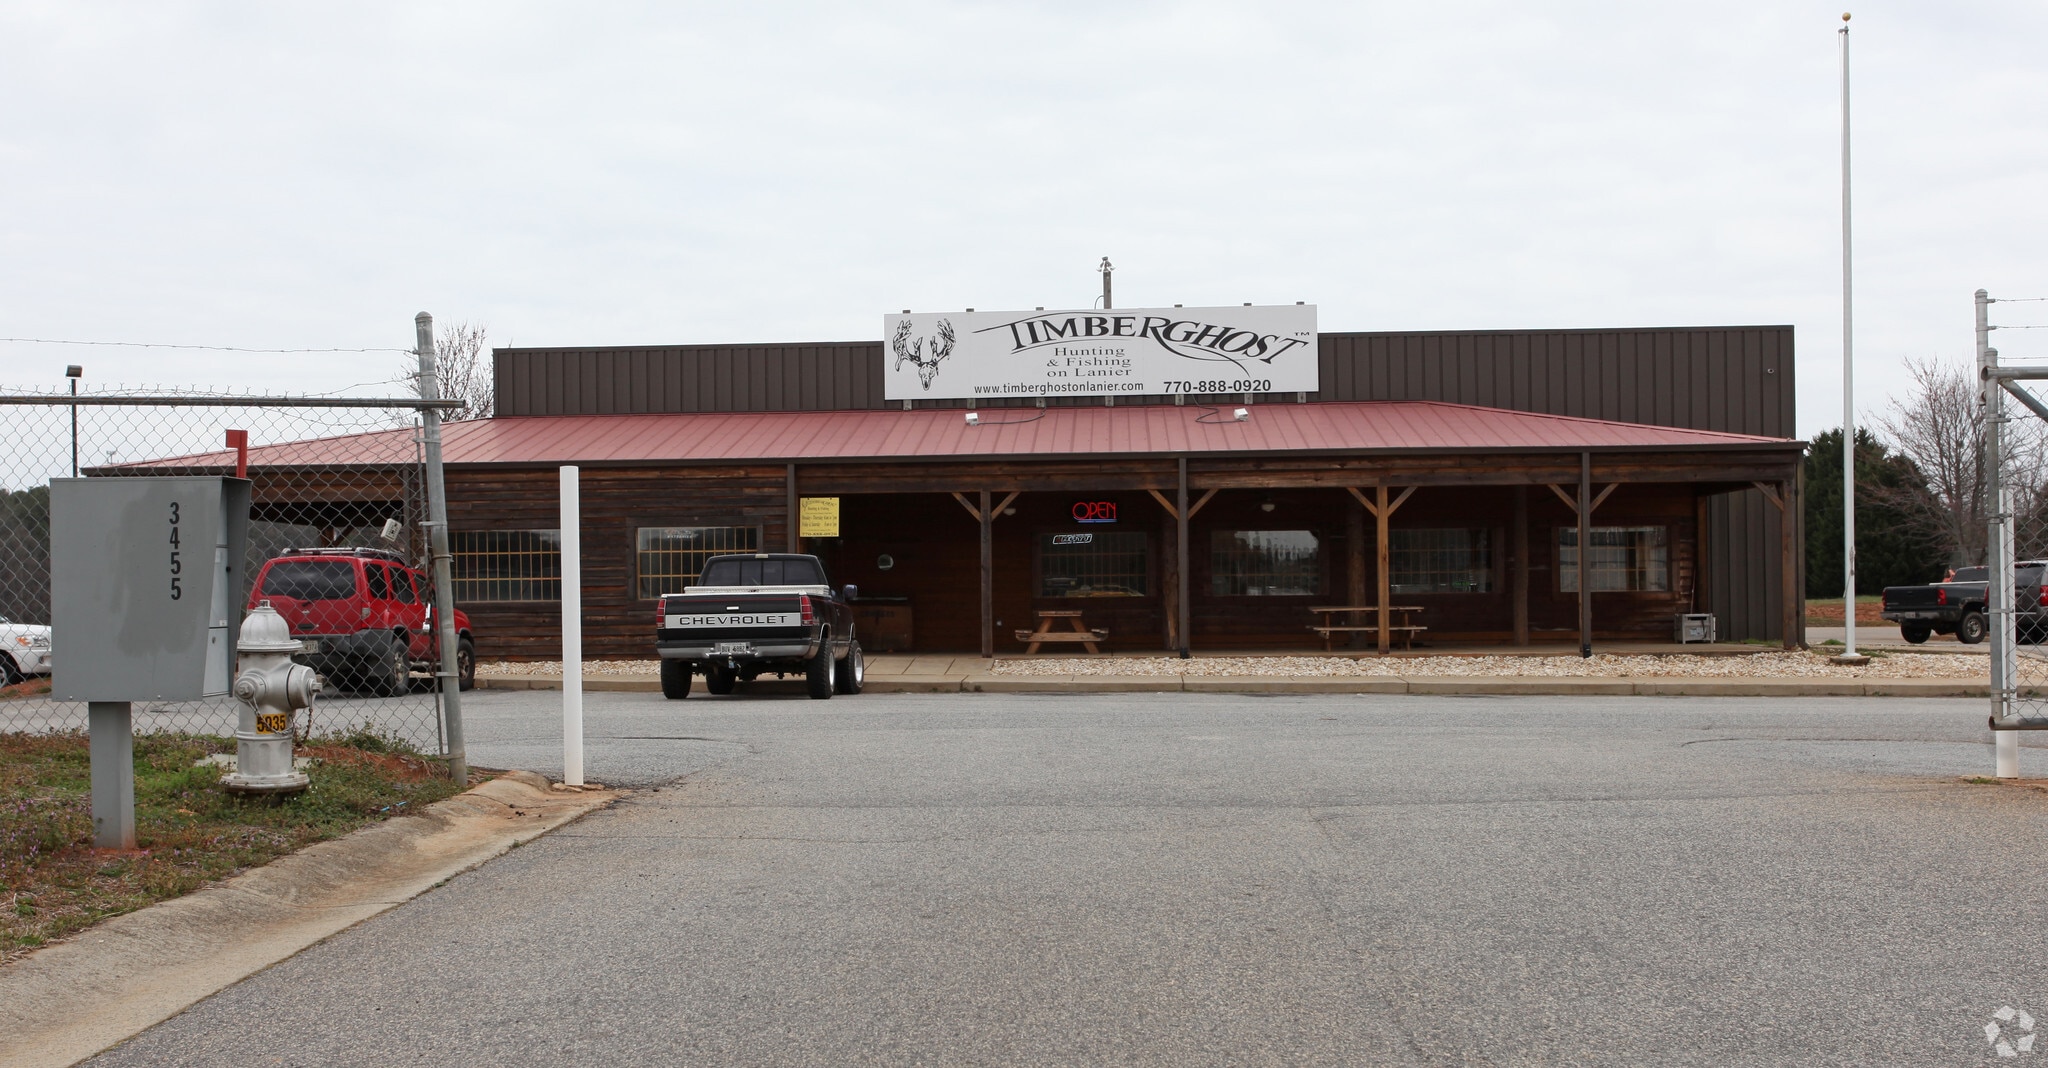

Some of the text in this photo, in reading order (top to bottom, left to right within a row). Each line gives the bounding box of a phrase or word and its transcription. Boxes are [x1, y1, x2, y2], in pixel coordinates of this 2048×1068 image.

[1008, 315, 1309, 364] TIMBERGHOST
[1055, 347, 1125, 358] Hunting
[1046, 357, 1131, 368] & Fishing
[1047, 366, 1132, 378] on Lanier
[974, 381, 1144, 395] www.timberghostonlanier.com
[1163, 379, 1271, 393] 770-888-0920
[1072, 501, 1116, 520] OPEN
[679, 615, 788, 625] CHEVROLET
